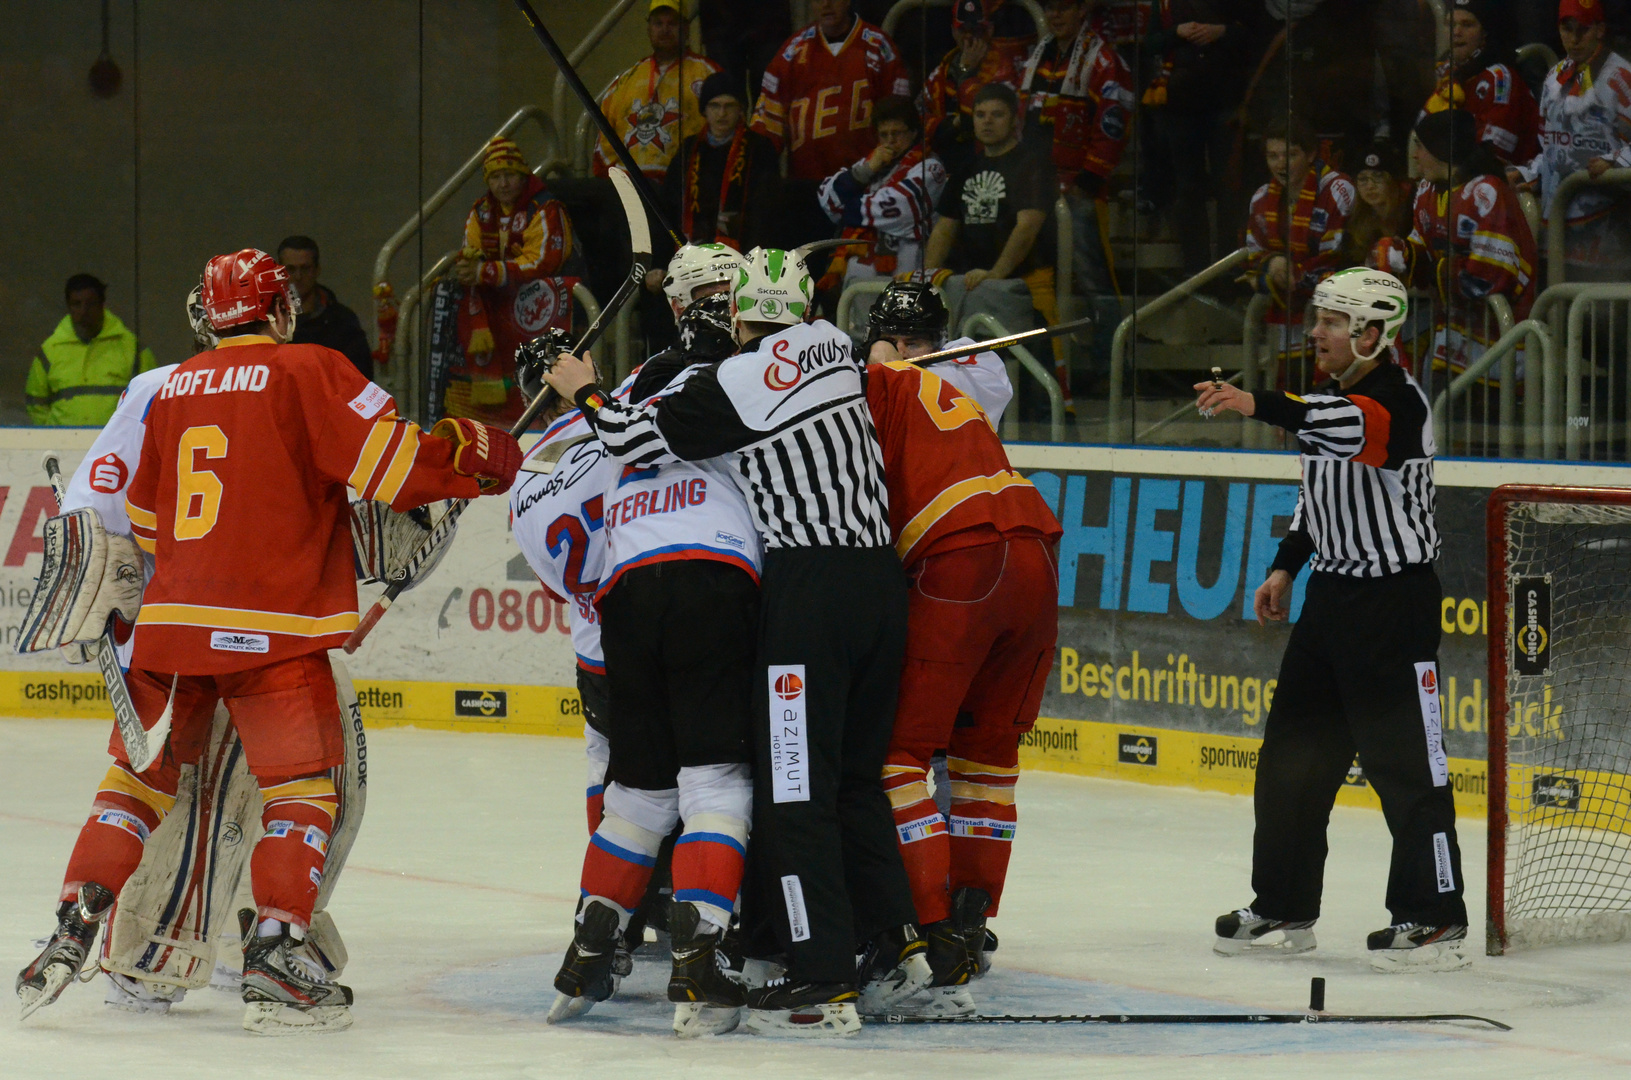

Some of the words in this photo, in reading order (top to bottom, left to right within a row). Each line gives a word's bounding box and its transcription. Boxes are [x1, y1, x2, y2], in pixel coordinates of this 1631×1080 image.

[160, 365, 270, 400] HOFLAND
[174, 425, 229, 541] 6
[1527, 589, 1538, 663] CASHPOINT
[461, 699, 502, 709] CASHPOINT
[348, 701, 367, 789] Reebok
[773, 735, 782, 771] HOTELS
